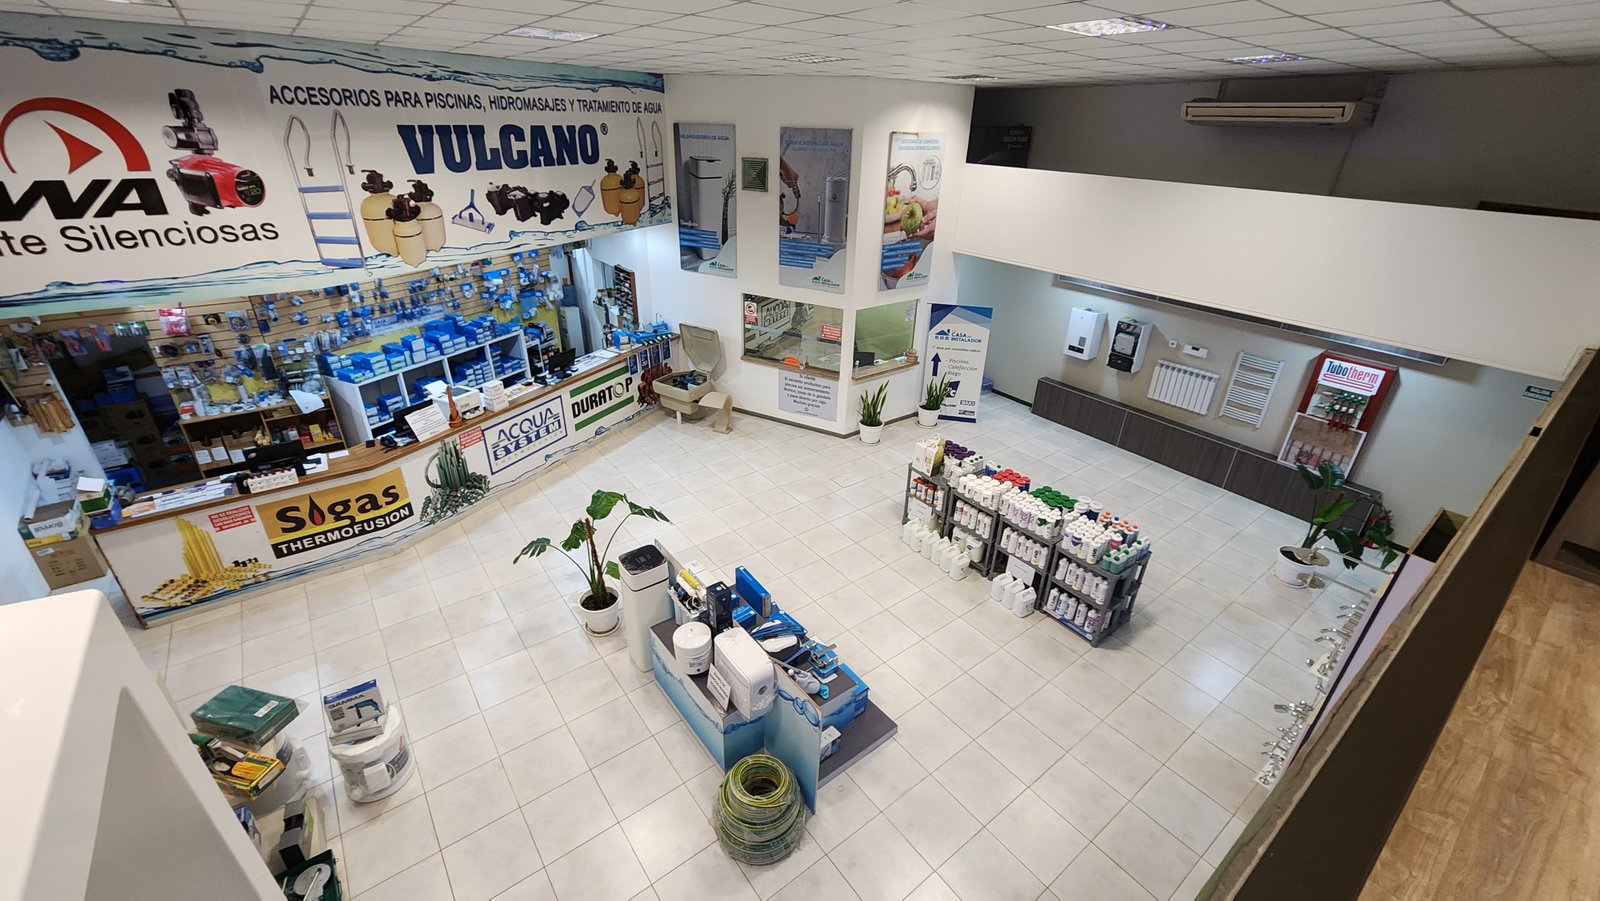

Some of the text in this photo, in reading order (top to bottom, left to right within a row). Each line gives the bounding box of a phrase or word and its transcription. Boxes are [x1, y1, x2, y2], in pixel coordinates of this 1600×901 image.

[269, 85, 663, 114] ACCESORIOS PARA PISCINAS, HIDROMASAJES Y TRATAMIENTO DE AGUA
[59, 220, 280, 253] Silenciosas
[950, 336, 982, 344] INSTALADOR
[571, 376, 634, 419] DURATOP
[494, 419, 561, 460] SYSTEM
[497, 407, 555, 442] ACQUA
[277, 506, 410, 555] THERMOFUSION
[328, 694, 365, 710] GAMMA
